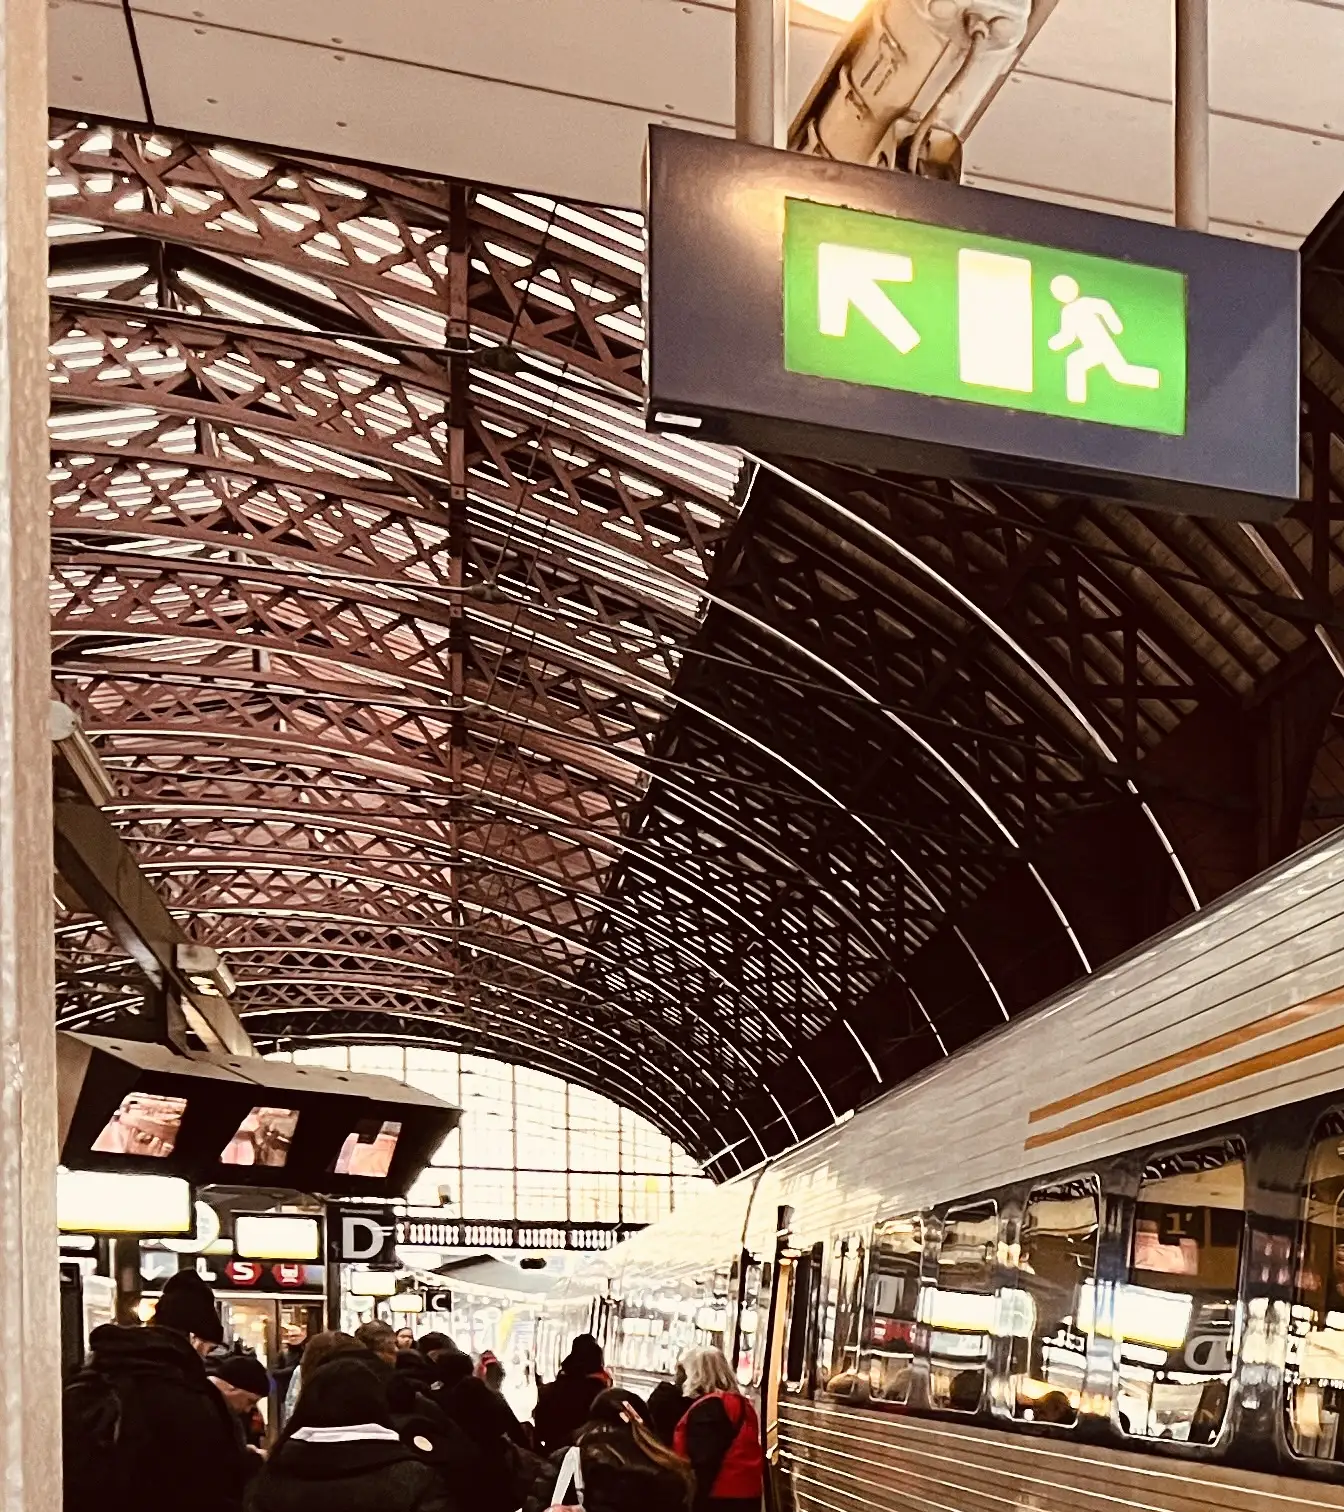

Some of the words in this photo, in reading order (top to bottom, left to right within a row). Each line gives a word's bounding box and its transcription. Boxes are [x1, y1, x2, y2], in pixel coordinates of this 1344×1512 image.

[342, 1217, 384, 1259] D
[233, 1262, 254, 1281] S
[431, 1294, 447, 1311] C
